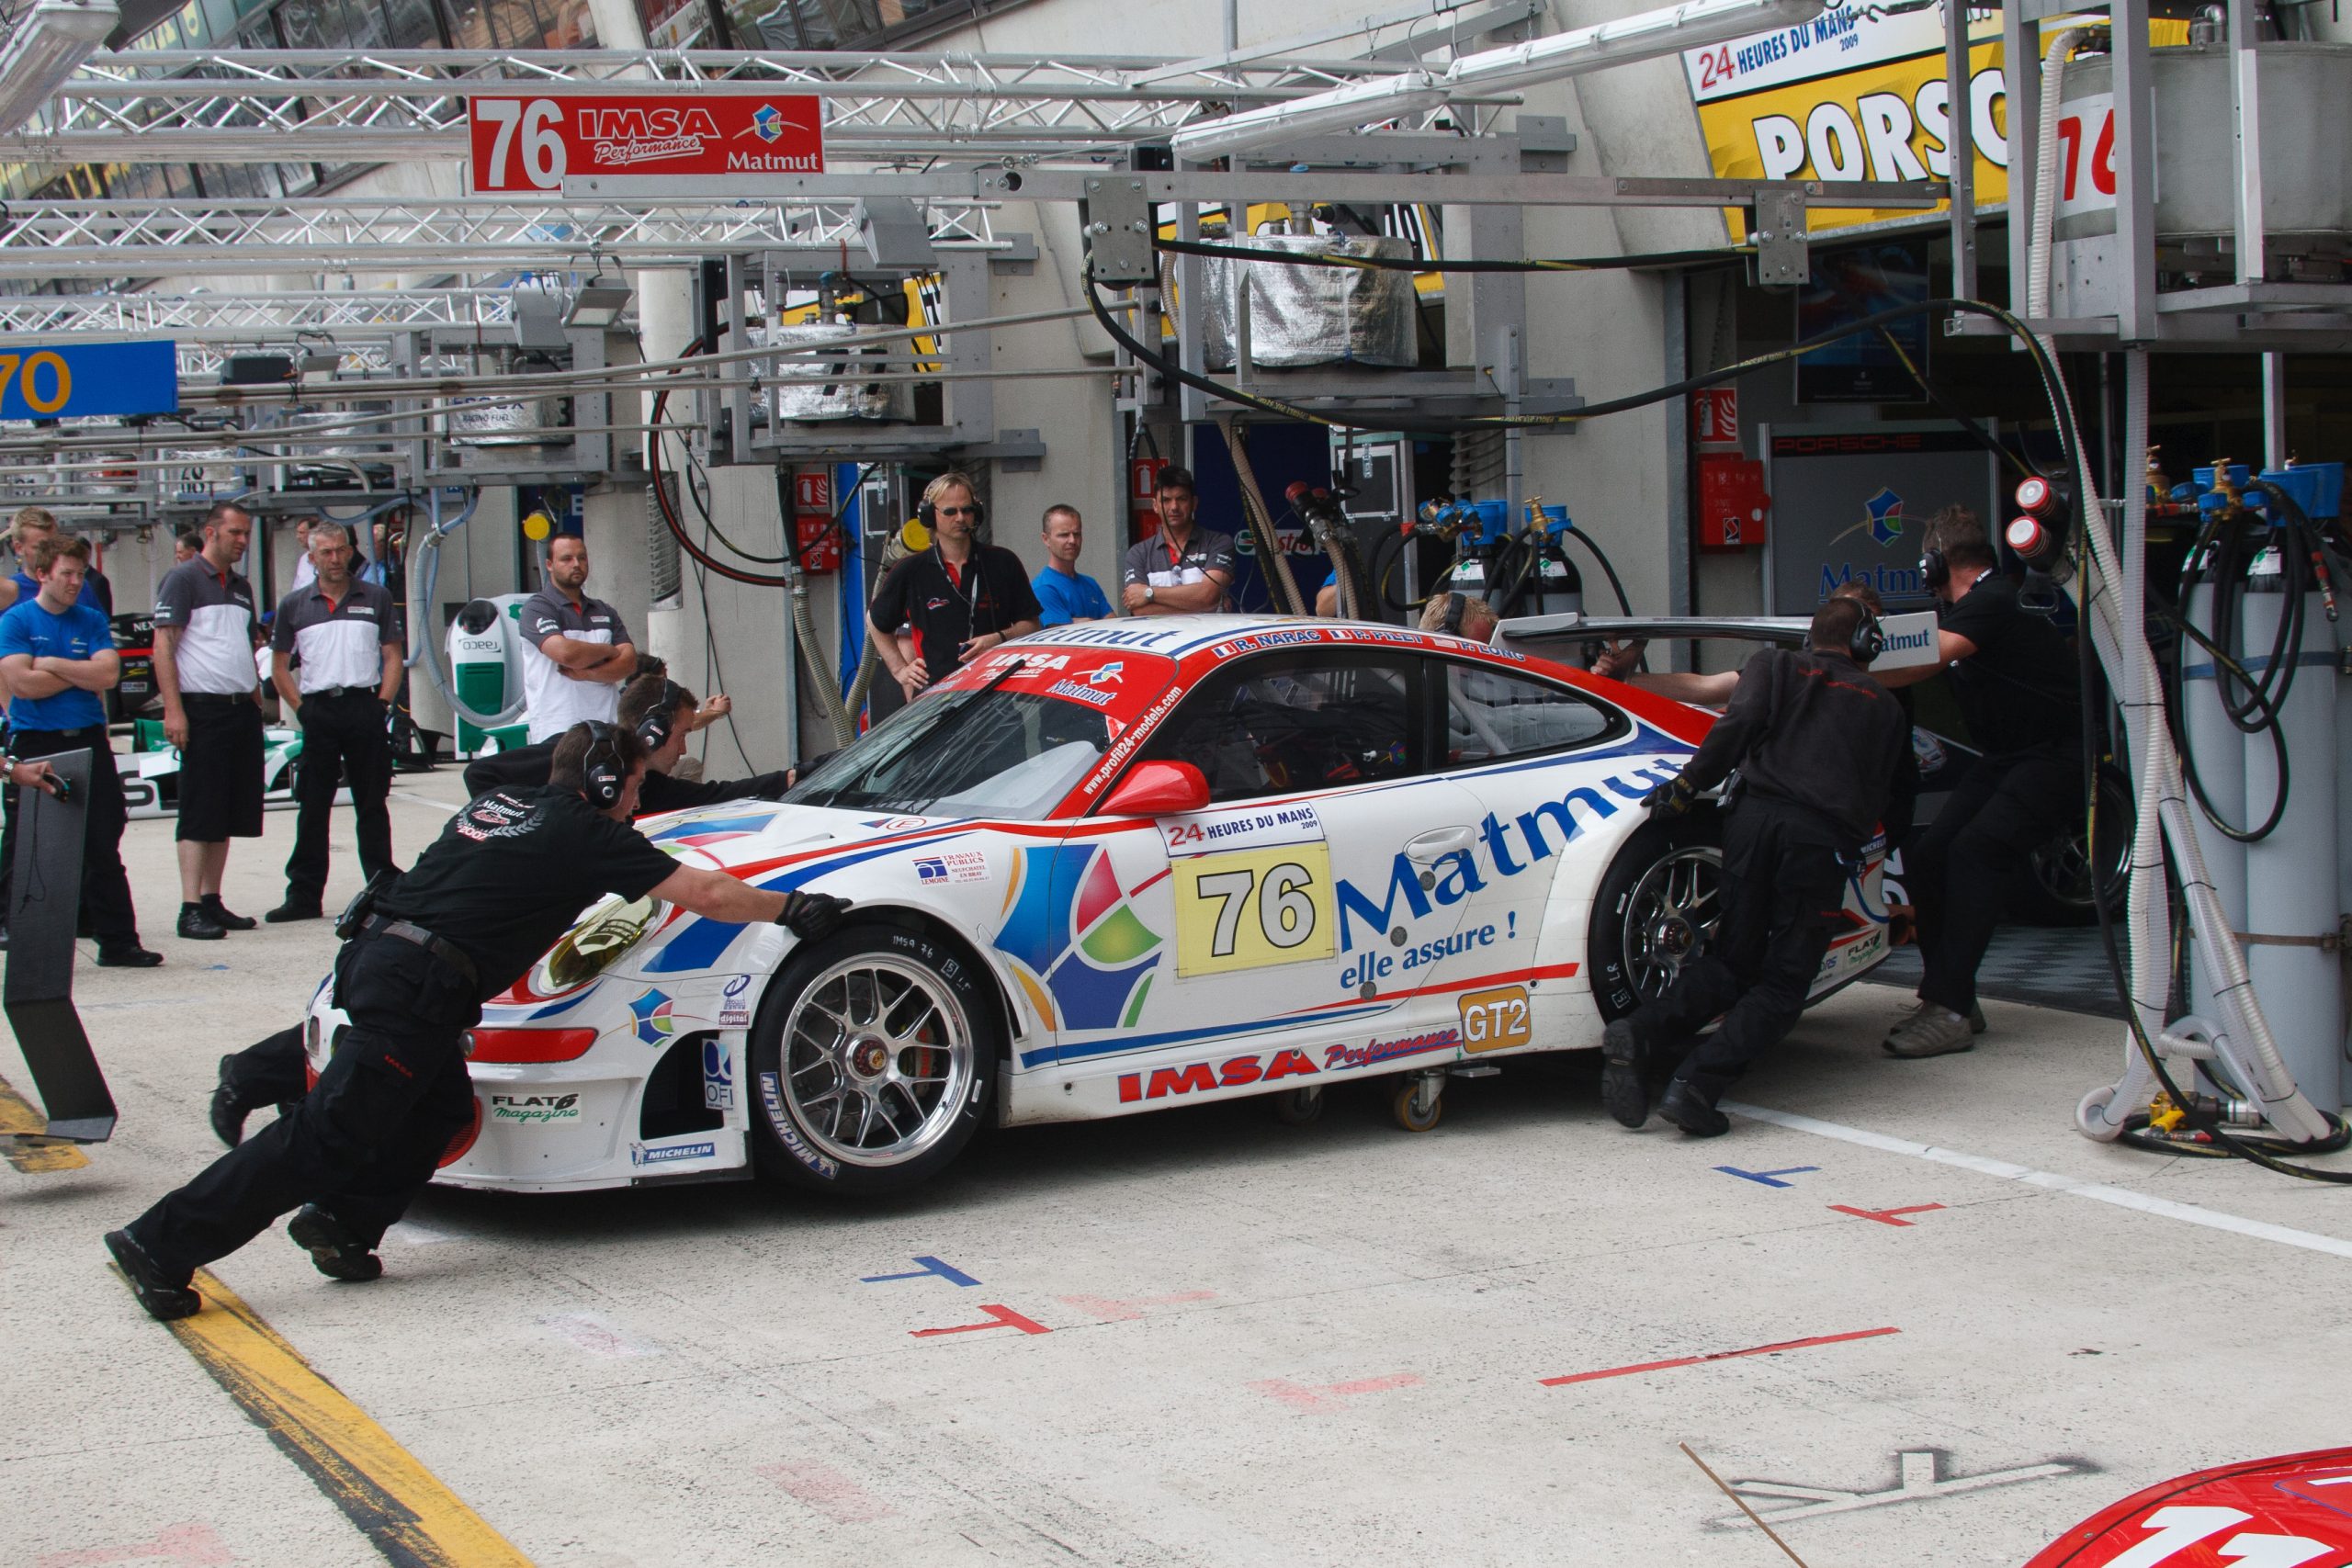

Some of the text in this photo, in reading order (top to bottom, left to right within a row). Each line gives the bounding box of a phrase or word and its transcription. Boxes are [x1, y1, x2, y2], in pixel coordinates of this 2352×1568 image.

[1699, 5, 1855, 91] 24 HEURES DU MANS
[1839, 33, 1859, 52] 2009
[578, 108, 721, 140] IMSA
[1752, 68, 2007, 182] PORSC
[476, 98, 567, 189] 76
[594, 137, 704, 165] Performance
[727, 152, 819, 171] Matmut
[1774, 434, 1922, 453] PORSCHE
[1253, 629, 1322, 649] NARAC
[1882, 629, 1930, 652] atmut
[986, 653, 1071, 671] IMSA
[1477, 644, 1526, 662] LONG
[1046, 678, 1118, 705] Matmut
[1083, 686, 1183, 795] www.profil24-models.com
[480, 798, 525, 819] Matmut
[458, 825, 489, 842] 2007
[1168, 807, 1314, 848] 24 HEURES DU MANS
[1301, 820, 1317, 830] 2009
[942, 851, 983, 862] TRAVAUX
[946, 857, 985, 867] PUBLICS
[922, 876, 950, 886] LEMOINE
[1196, 862, 1316, 957] 76
[1340, 950, 1393, 989] elle
[1402, 922, 1496, 972] assure
[720, 1014, 748, 1024] digital
[1464, 998, 1527, 1043] GT2
[1118, 1027, 1462, 1104] IMSA Performance
[761, 1075, 817, 1165] MICHELIN
[648, 1145, 713, 1161] MICHELIN
